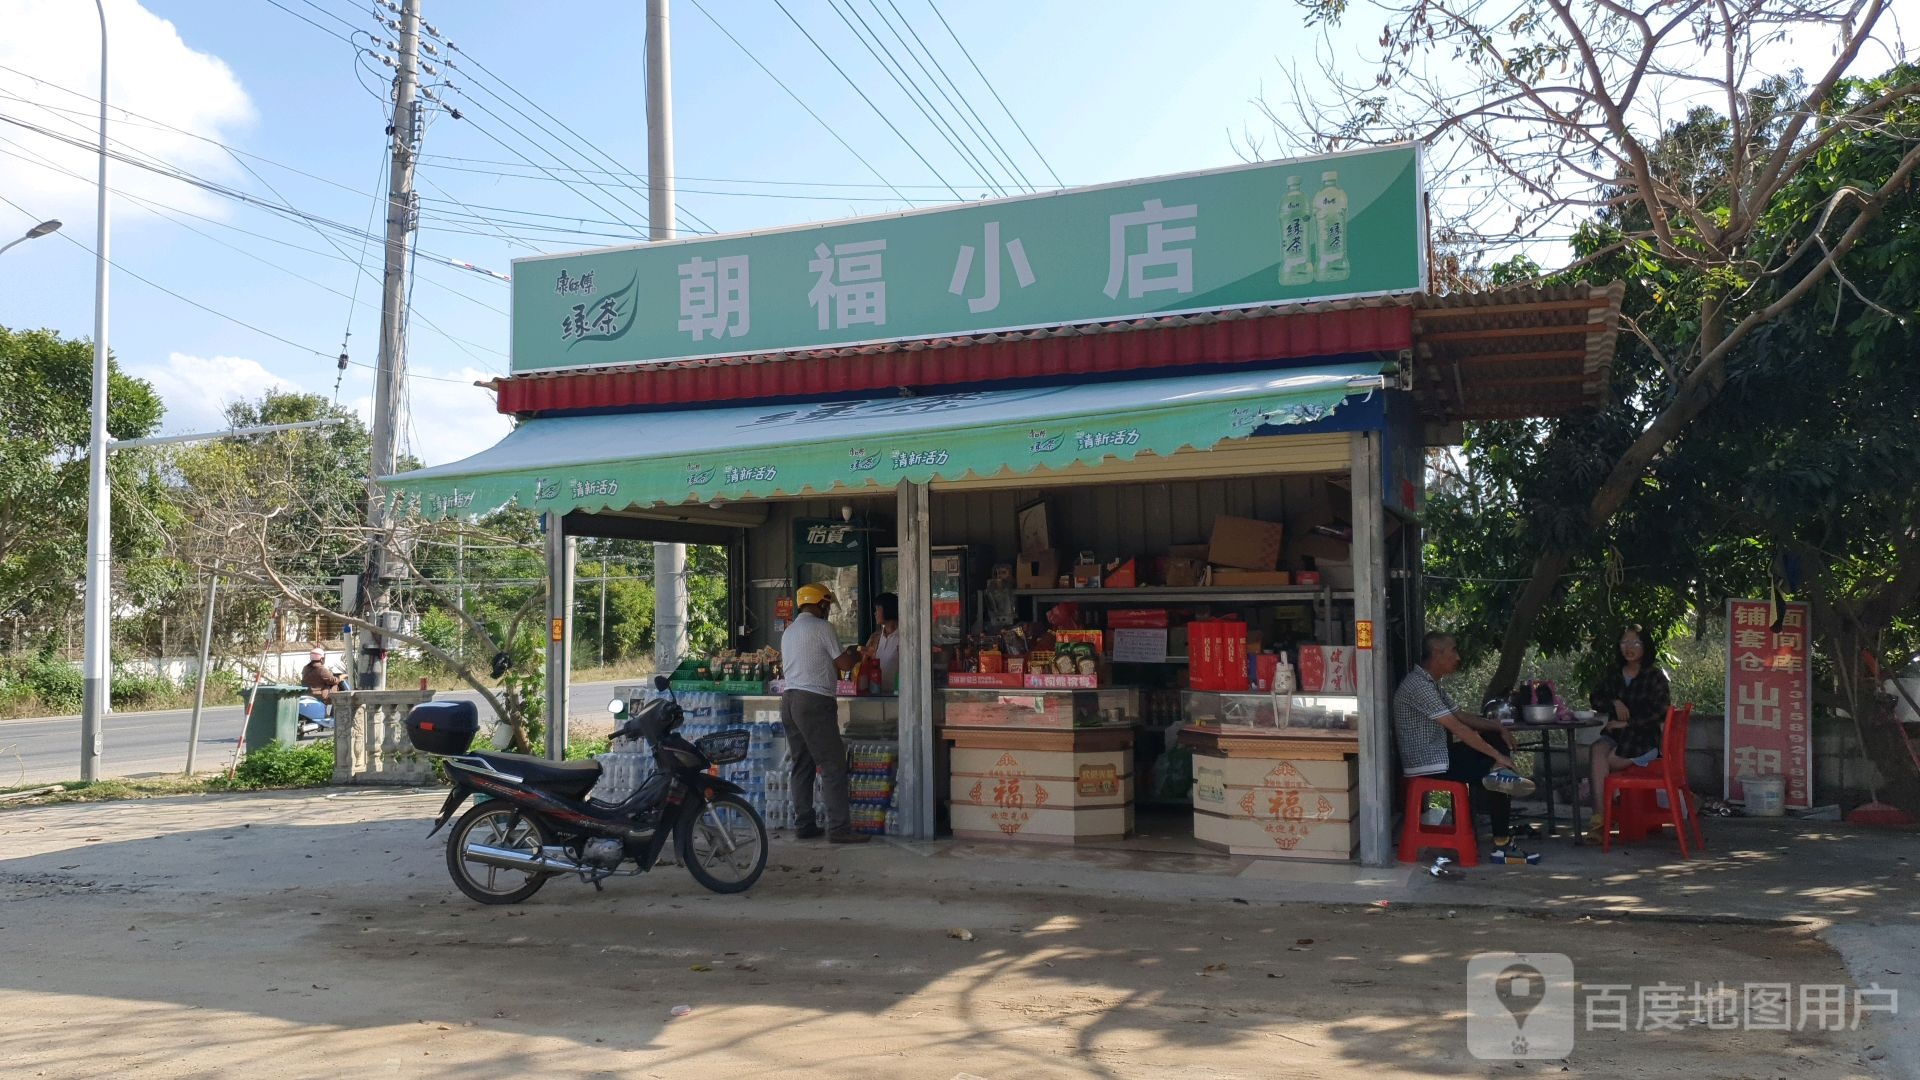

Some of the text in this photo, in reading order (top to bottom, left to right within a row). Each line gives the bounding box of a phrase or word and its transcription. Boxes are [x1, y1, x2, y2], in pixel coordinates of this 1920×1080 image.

[677, 198, 1198, 341] 朝福小店
[561, 299, 618, 340] 绿茶
[1078, 430, 1141, 451] 清新活力
[893, 450, 949, 470] 清新活力
[727, 465, 777, 485] 清新活力
[572, 479, 619, 500] 清新活力
[1734, 605, 1804, 628] 铺面
[1734, 629, 1803, 651] 套间
[1734, 651, 1803, 675] 仓库
[1734, 681, 1782, 782] 出租
[993, 777, 1024, 809] 福
[1268, 789, 1305, 822] 福
